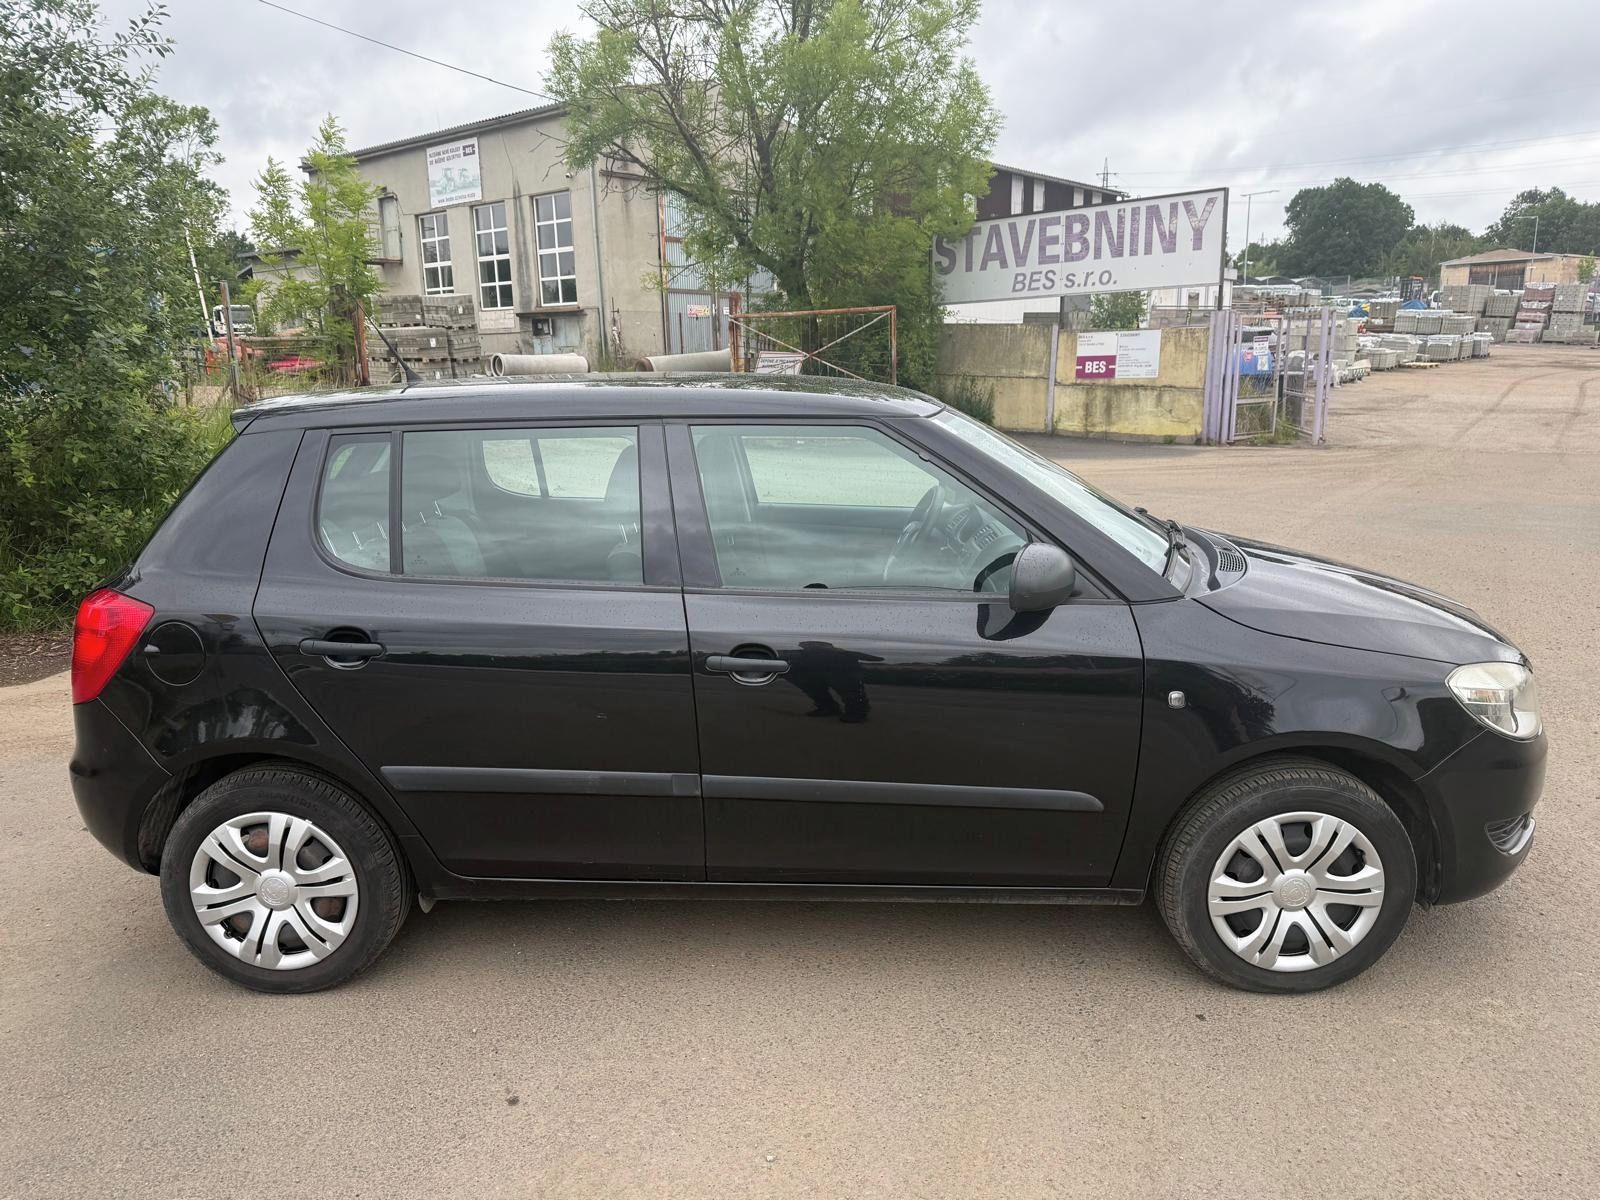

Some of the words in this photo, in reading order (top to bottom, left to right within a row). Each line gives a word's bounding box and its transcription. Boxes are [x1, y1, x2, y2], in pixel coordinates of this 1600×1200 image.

[934, 196, 1218, 276] STAVEBNINY
[1011, 269, 1057, 293] BES
[1064, 269, 1118, 289] s.r.o.
[1084, 360, 1107, 374] BES
